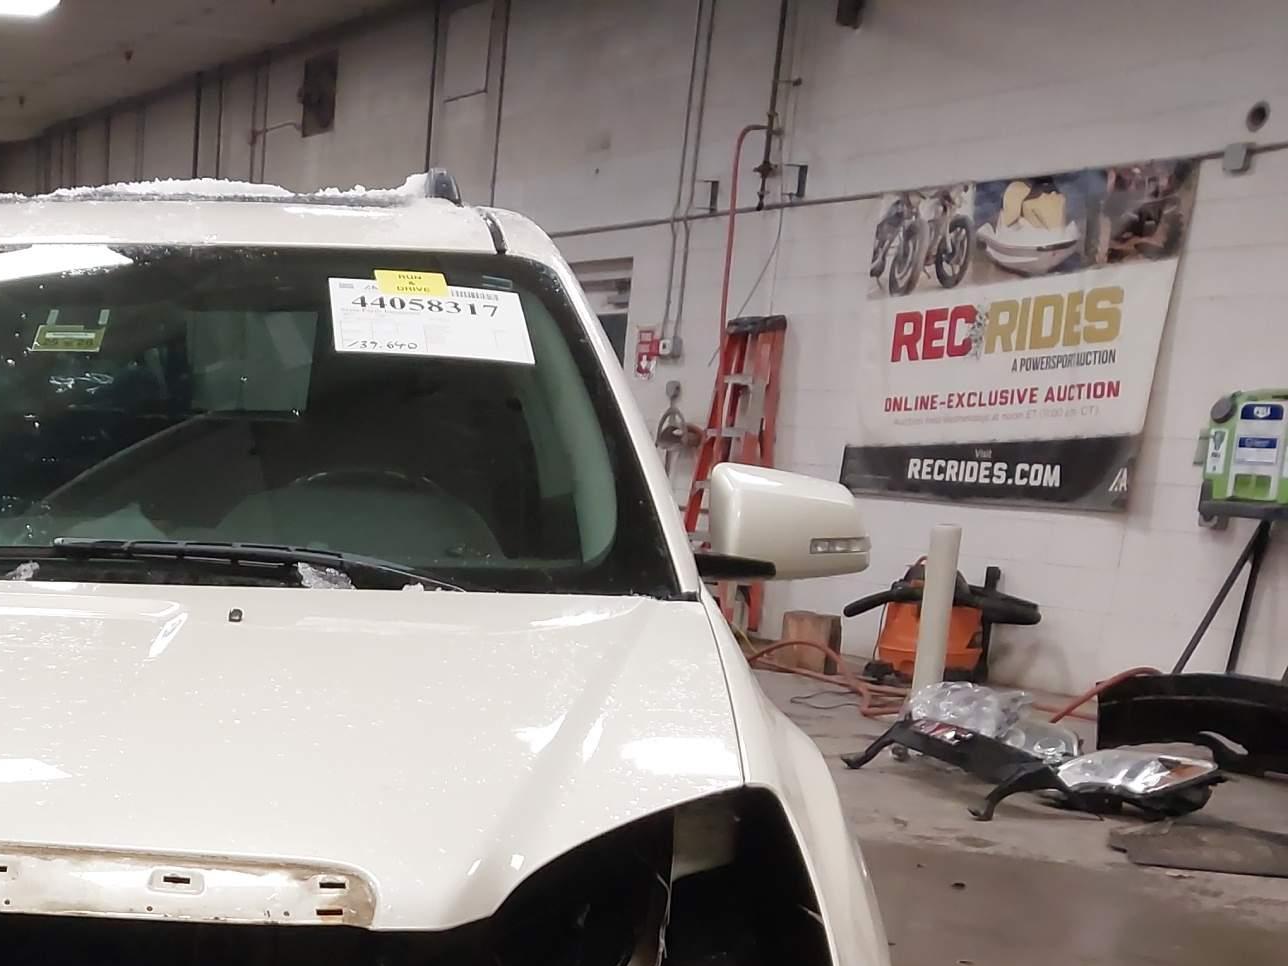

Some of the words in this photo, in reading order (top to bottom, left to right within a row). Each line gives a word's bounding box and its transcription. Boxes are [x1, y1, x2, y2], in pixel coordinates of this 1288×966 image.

[351, 295, 499, 318] 44058317
[891, 304, 979, 363] REC
[983, 286, 1125, 354] RIDES
[1011, 358, 1018, 373] A
[884, 387, 1039, 413] ONLINE-EXCLUSIVE
[1044, 380, 1121, 402] AUCTION
[974, 448, 993, 459] Visit
[907, 458, 1061, 488] RECRIDES.COM
